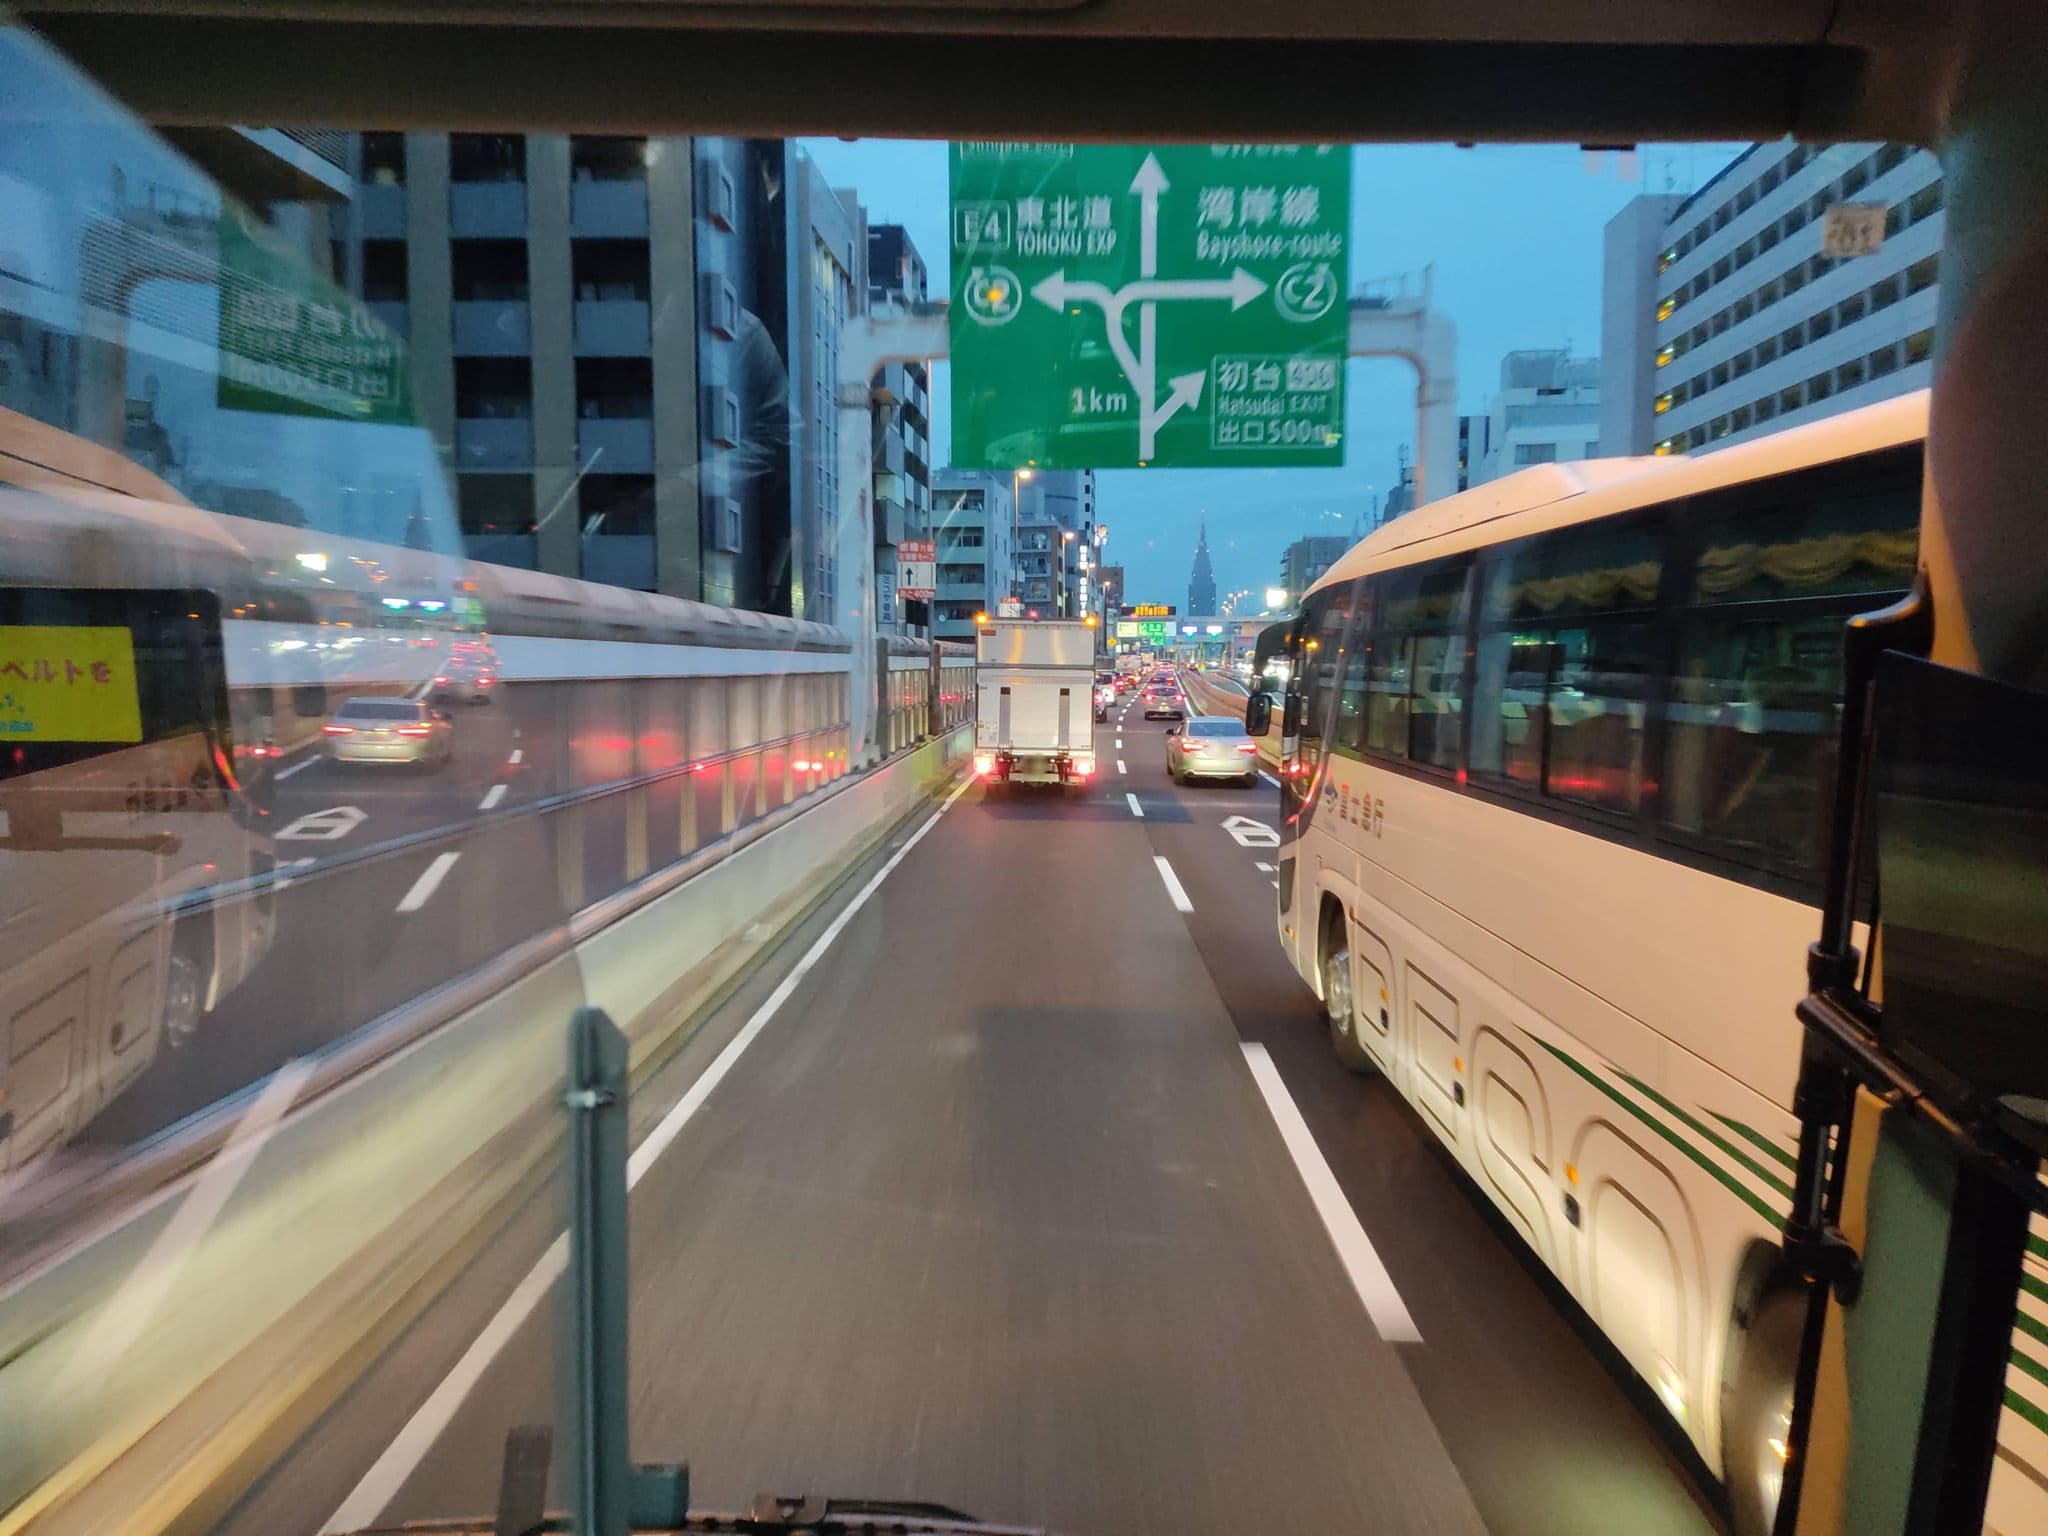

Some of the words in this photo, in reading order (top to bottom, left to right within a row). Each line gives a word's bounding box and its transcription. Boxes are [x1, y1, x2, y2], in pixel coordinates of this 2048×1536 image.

[1016, 196, 1113, 231] 東北道
[1197, 184, 1321, 229] 湾岸線
[963, 210, 1001, 241] E4
[1017, 230, 1081, 255] TOHOKU
[1087, 230, 1117, 255] EXP
[973, 277, 1010, 314] C2
[1283, 274, 1325, 310] C2
[1218, 360, 1282, 392] 初台
[1071, 386, 1128, 414] 1km
